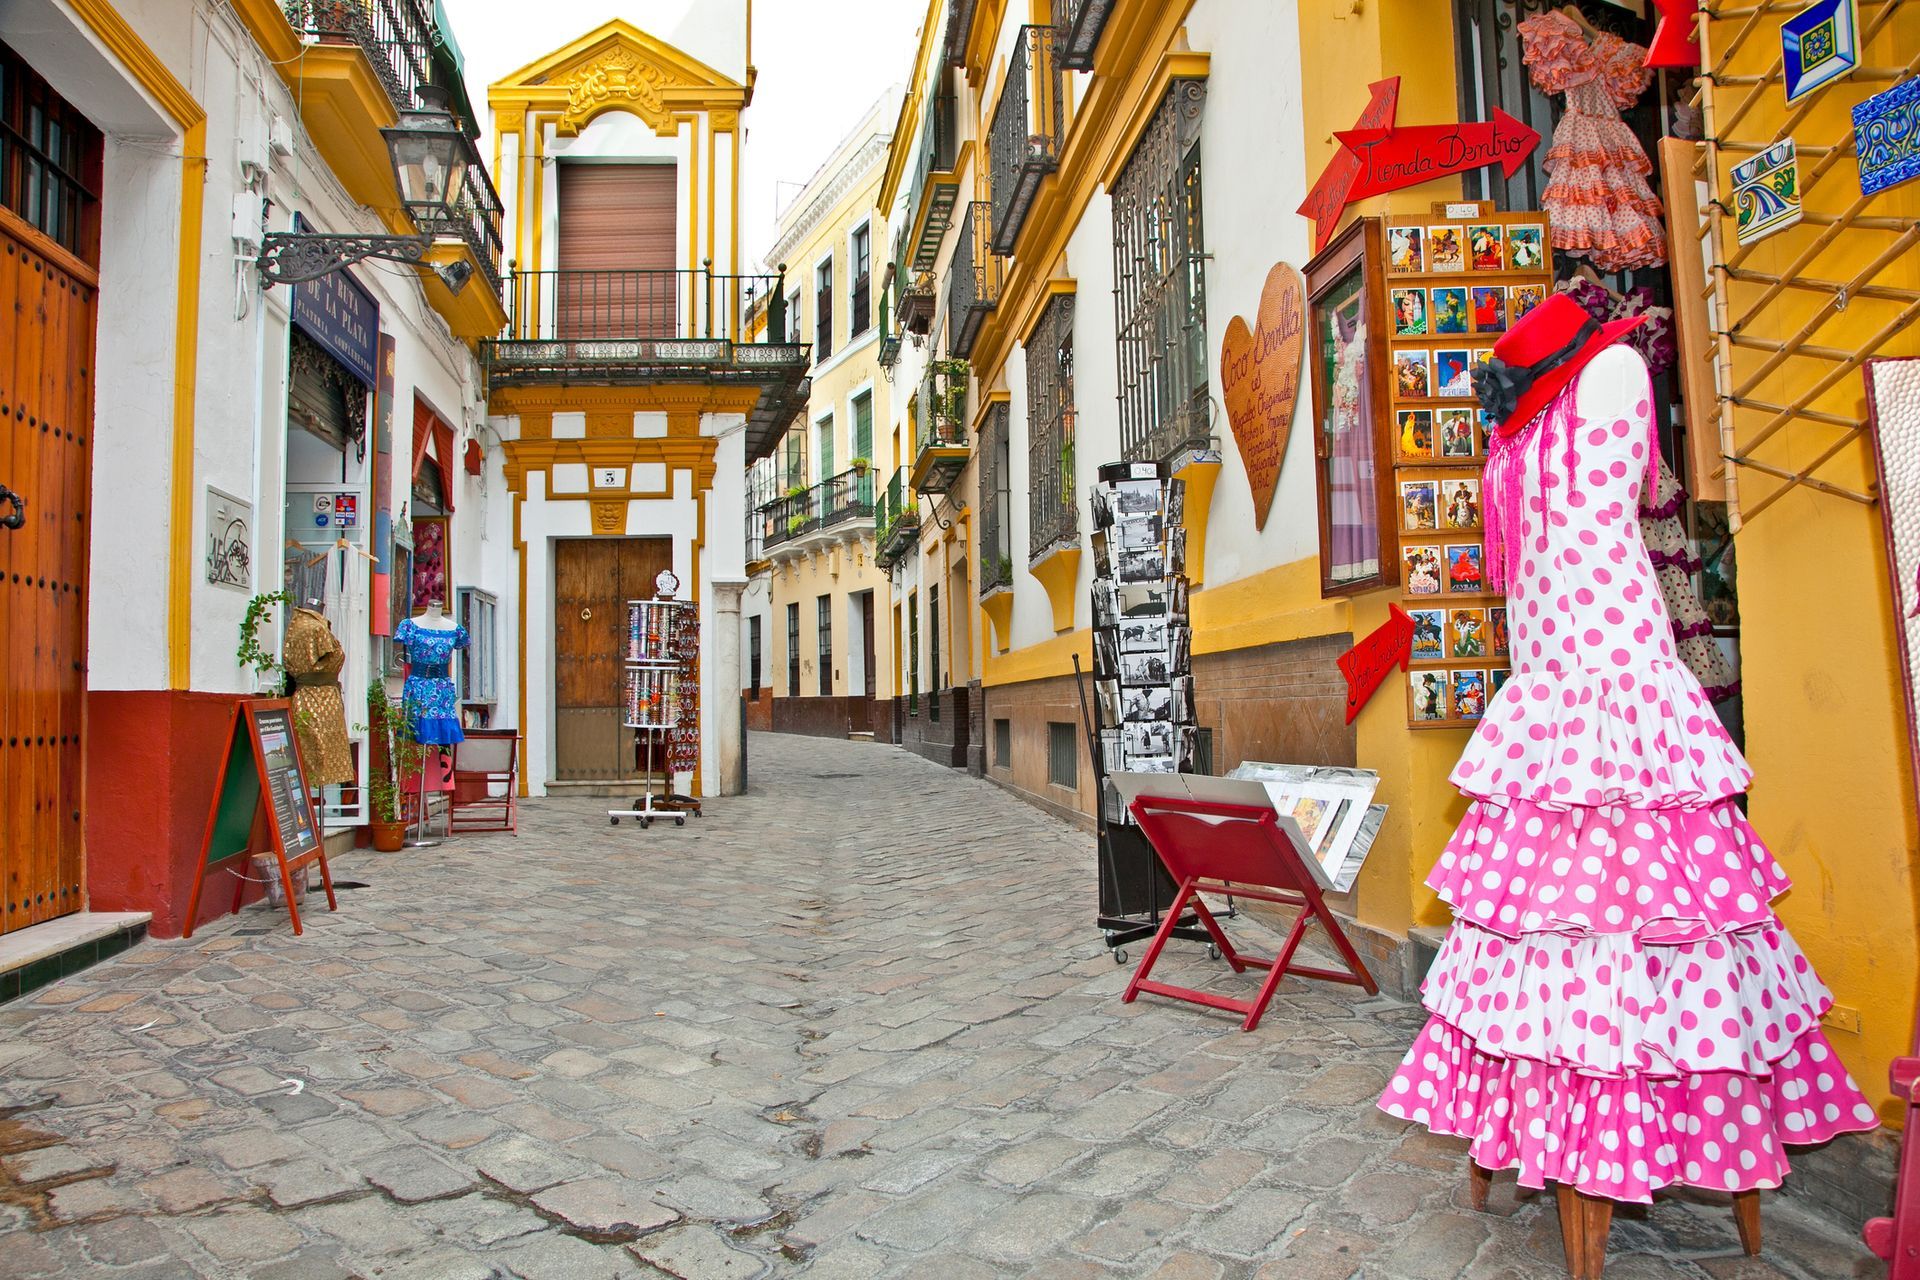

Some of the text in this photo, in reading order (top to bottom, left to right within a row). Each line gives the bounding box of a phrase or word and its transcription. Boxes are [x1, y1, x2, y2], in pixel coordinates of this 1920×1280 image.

[1354, 124, 1531, 188] Tienda Dentro
[308, 279, 367, 349] DE LA PLATA
[337, 278, 359, 316] RUTA
[1222, 347, 1251, 393] Coco
